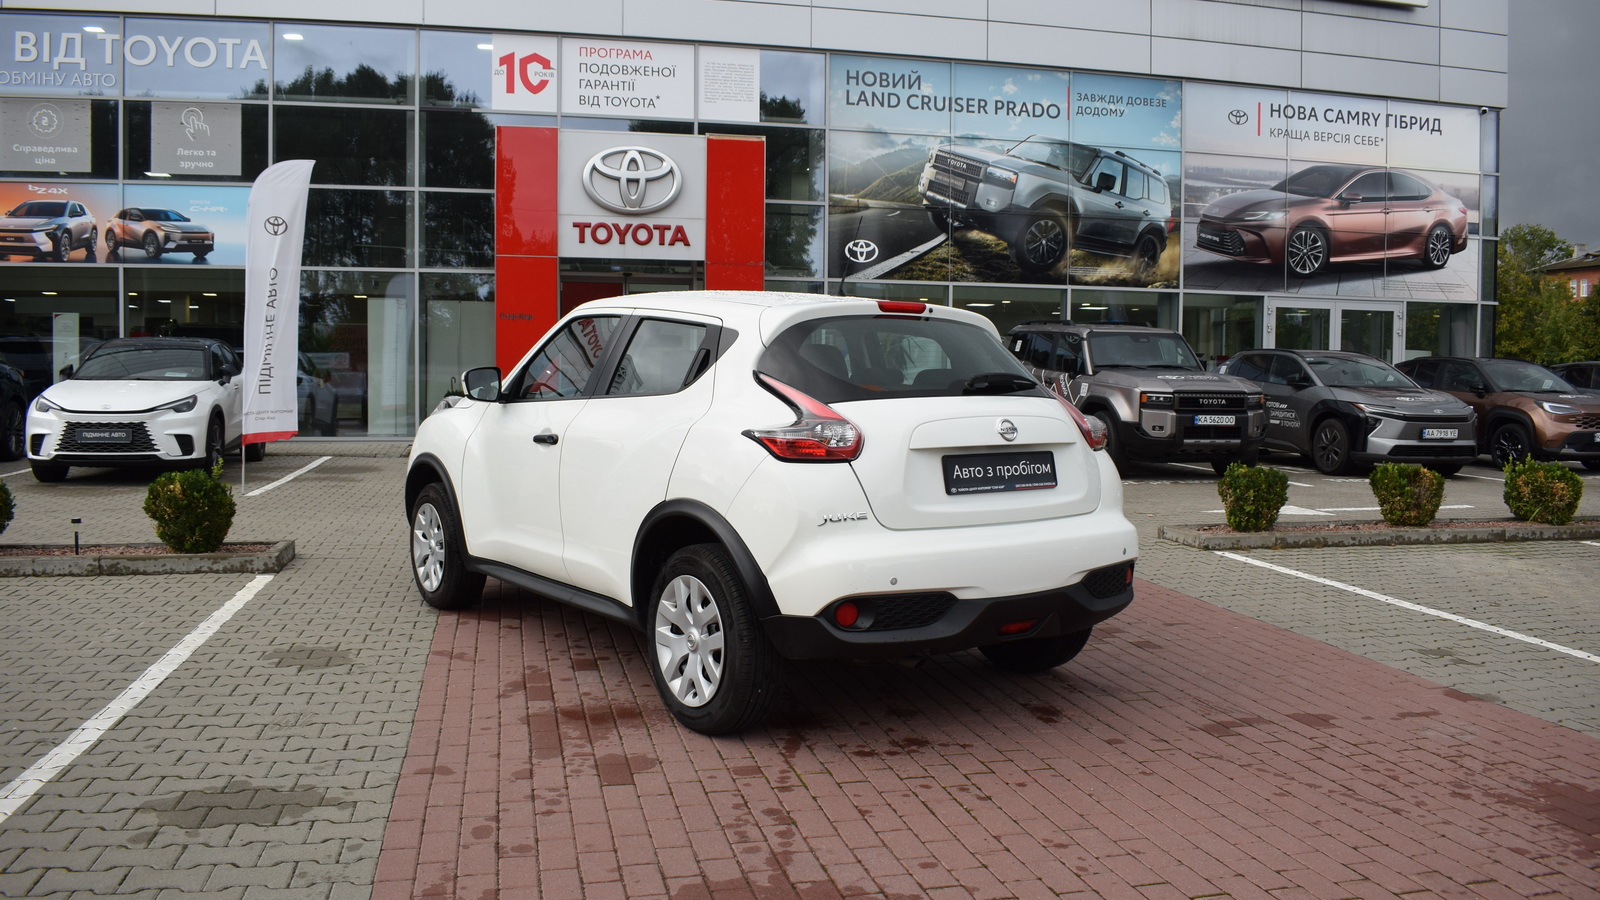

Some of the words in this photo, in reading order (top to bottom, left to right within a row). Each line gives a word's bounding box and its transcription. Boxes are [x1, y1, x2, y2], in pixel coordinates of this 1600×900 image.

[15, 31, 86, 70] ВІД
[97, 33, 269, 70] TOYOTA
[579, 46, 653, 60] ПРОГРАМА
[579, 62, 677, 78] ПОДОВЖЕНОЇ
[0, 71, 66, 86] ОБМІНУ
[71, 73, 116, 87] АВТО
[579, 78, 636, 92] ГАРАНТІЇ
[846, 69, 921, 91] НОВИЙ
[579, 94, 601, 108] ВІД
[846, 89, 901, 108] LAND
[906, 93, 988, 115] CRUISER
[994, 99, 1061, 119] PRADO
[1076, 92, 1124, 105] ЗАВЖДИ
[1126, 96, 1167, 108] ДОВЕЗЕ
[1076, 106, 1125, 118] ДОДОМУ
[1270, 103, 1319, 122] НОВА
[1323, 108, 1381, 128] CAMRY
[1385, 113, 1443, 136] ГІБРИД
[1269, 127, 1311, 142] КРАЩА
[1313, 131, 1351, 144] ВЕРСІЯ
[12, 143, 78, 154] Справедлива
[177, 148, 204, 156] Легко
[35, 156, 56, 165] ціна
[179, 161, 214, 169] зручно
[947, 158, 967, 169] TOYOTA
[572, 222, 691, 247] TOYOTA
[1199, 416, 1208, 424] KA
[1208, 416, 1224, 424] 5620
[953, 464, 984, 479] Авто
[986, 466, 994, 477] з
[996, 461, 1052, 479] пробігом
[817, 511, 868, 527] JUKE
